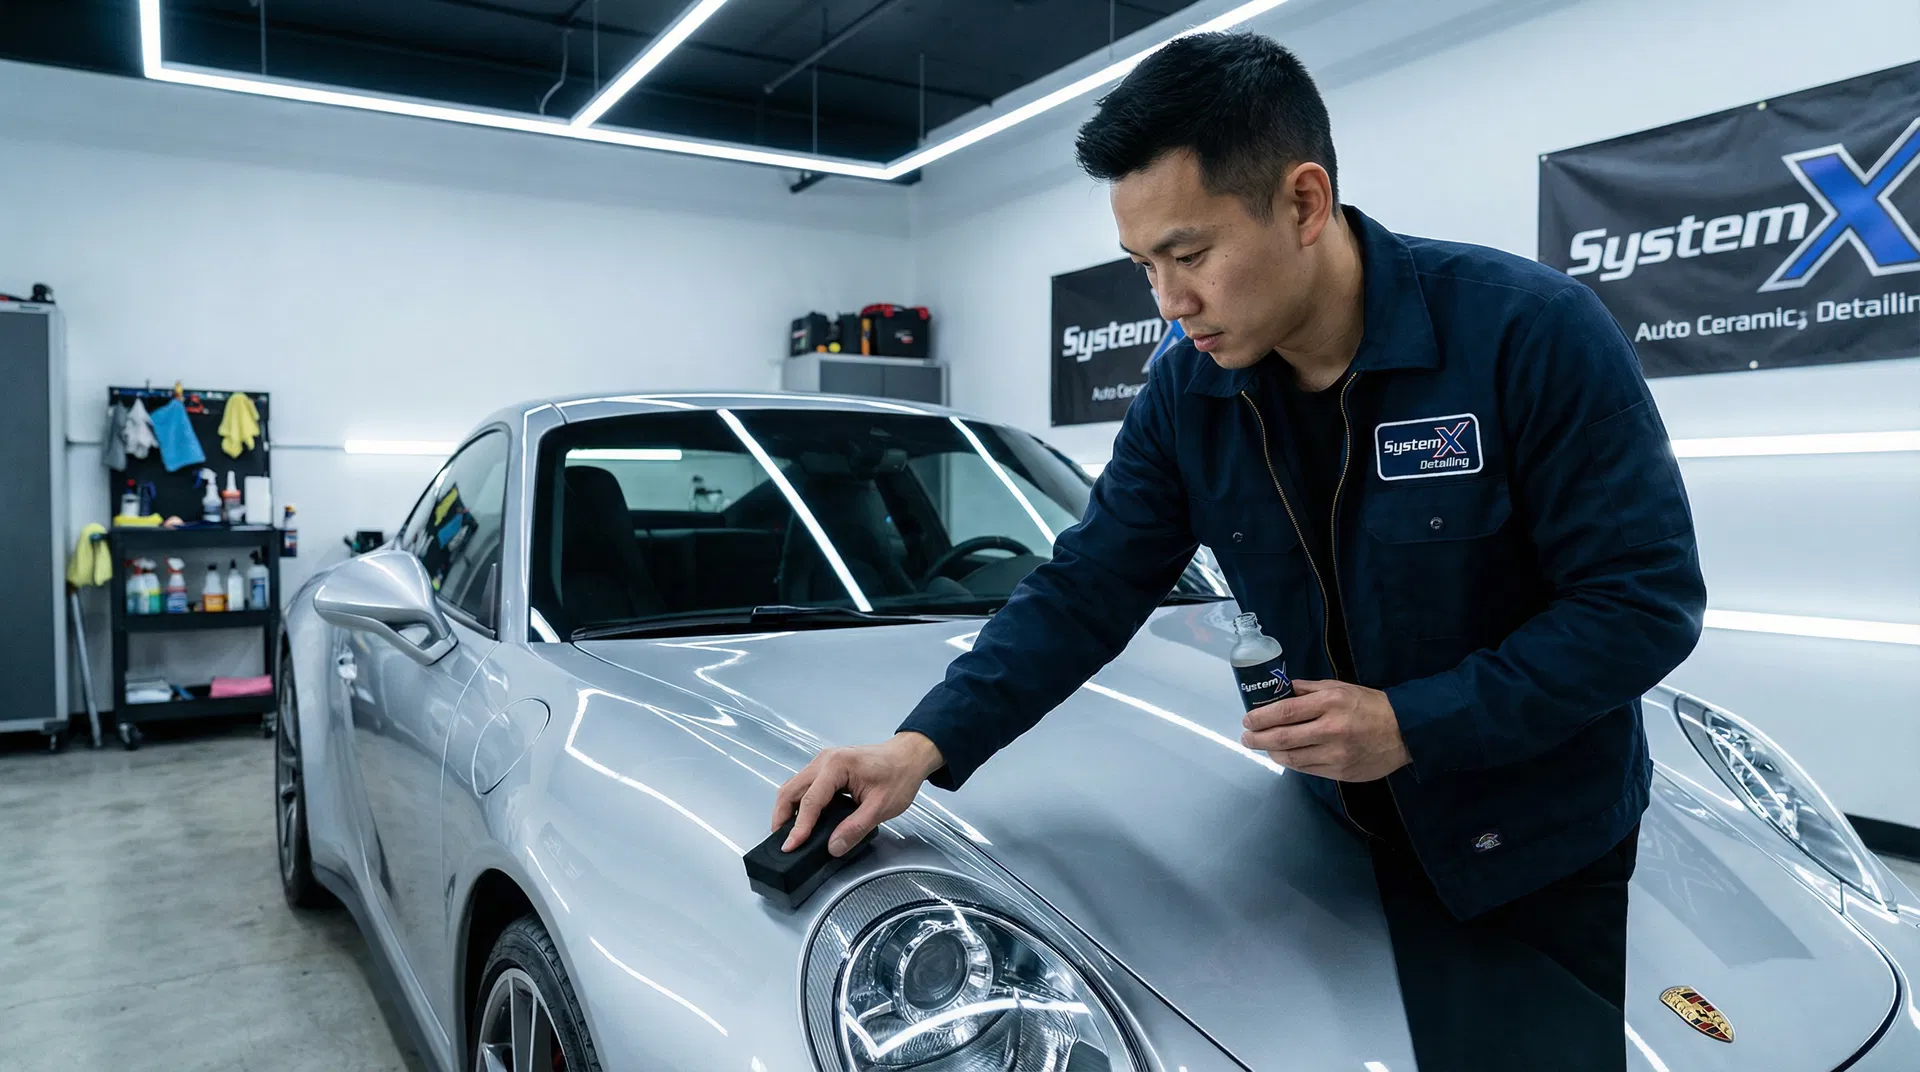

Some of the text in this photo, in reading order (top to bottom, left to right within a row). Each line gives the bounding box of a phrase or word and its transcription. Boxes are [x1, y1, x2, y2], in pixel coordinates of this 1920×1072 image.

[1566, 117, 1920, 294] SystemX
[1635, 321, 1691, 342] Auto
[1383, 420, 1470, 458] SystemX
